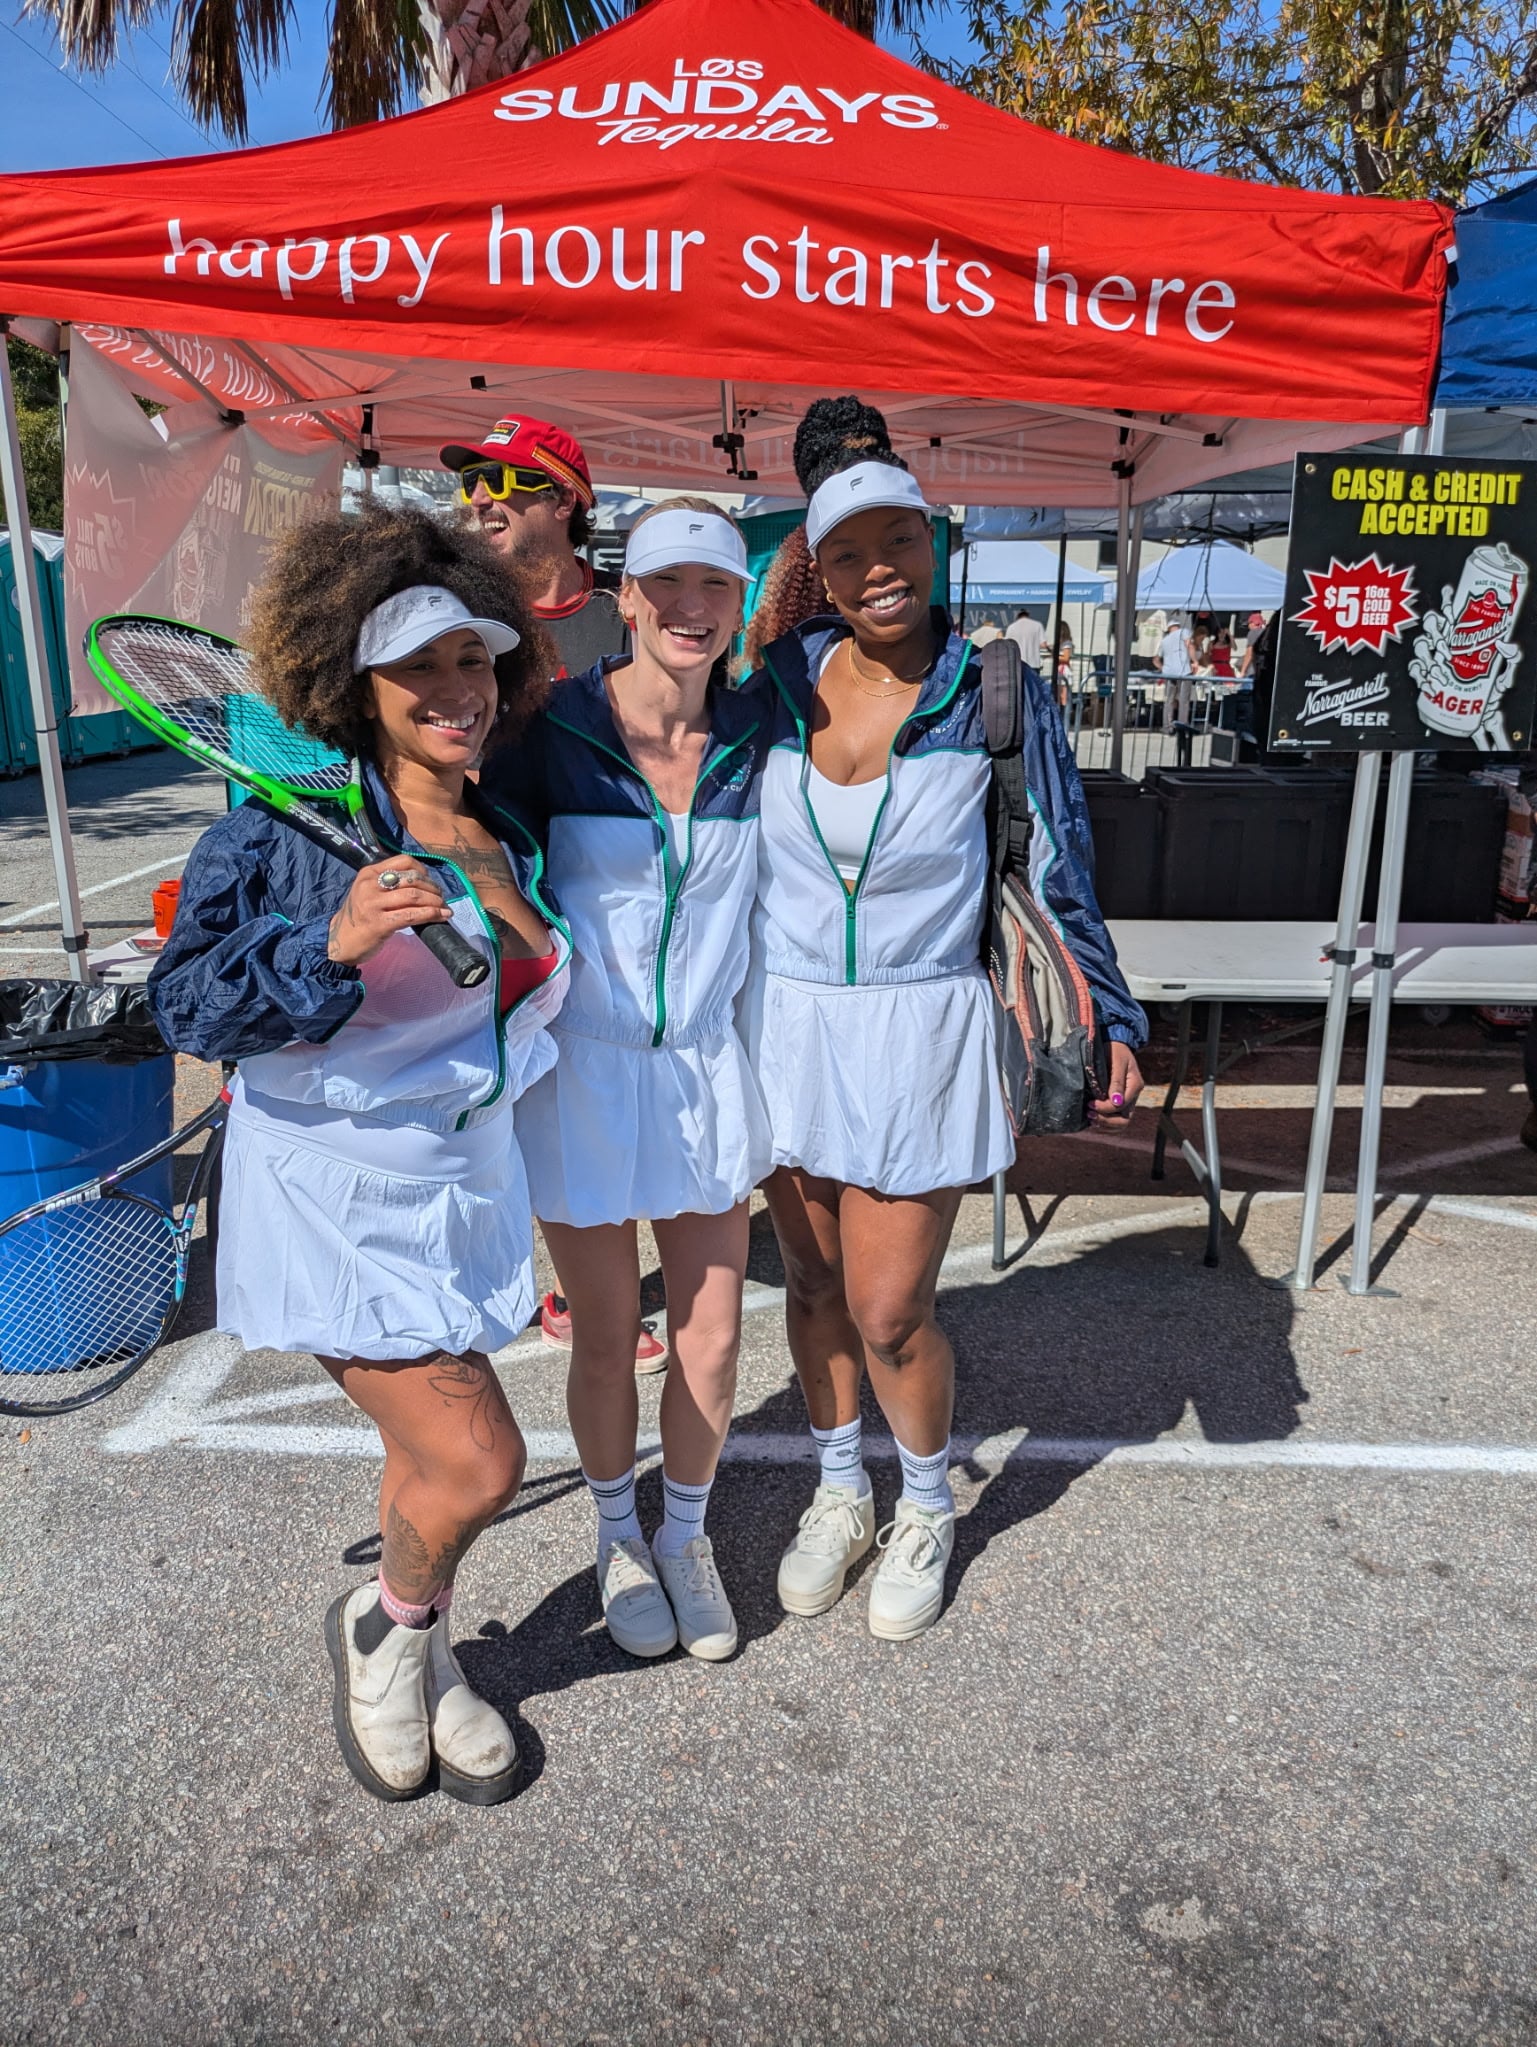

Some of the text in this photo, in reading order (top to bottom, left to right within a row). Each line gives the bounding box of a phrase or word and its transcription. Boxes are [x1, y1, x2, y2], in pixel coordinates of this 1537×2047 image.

[493, 79, 940, 130] SUNDAYS
[596, 117, 834, 150] Tequila
[163, 204, 1237, 344] happy hour starts here
[1331, 467, 1523, 506] CASH & CREDIT
[1359, 503, 1489, 537] ACCEPTED
[1324, 585, 1361, 629] $5
[1361, 612, 1389, 627] BEER
[1363, 598, 1392, 614] COLD
[1295, 672, 1391, 722] Narragansett
[1340, 711, 1391, 727] BEER
